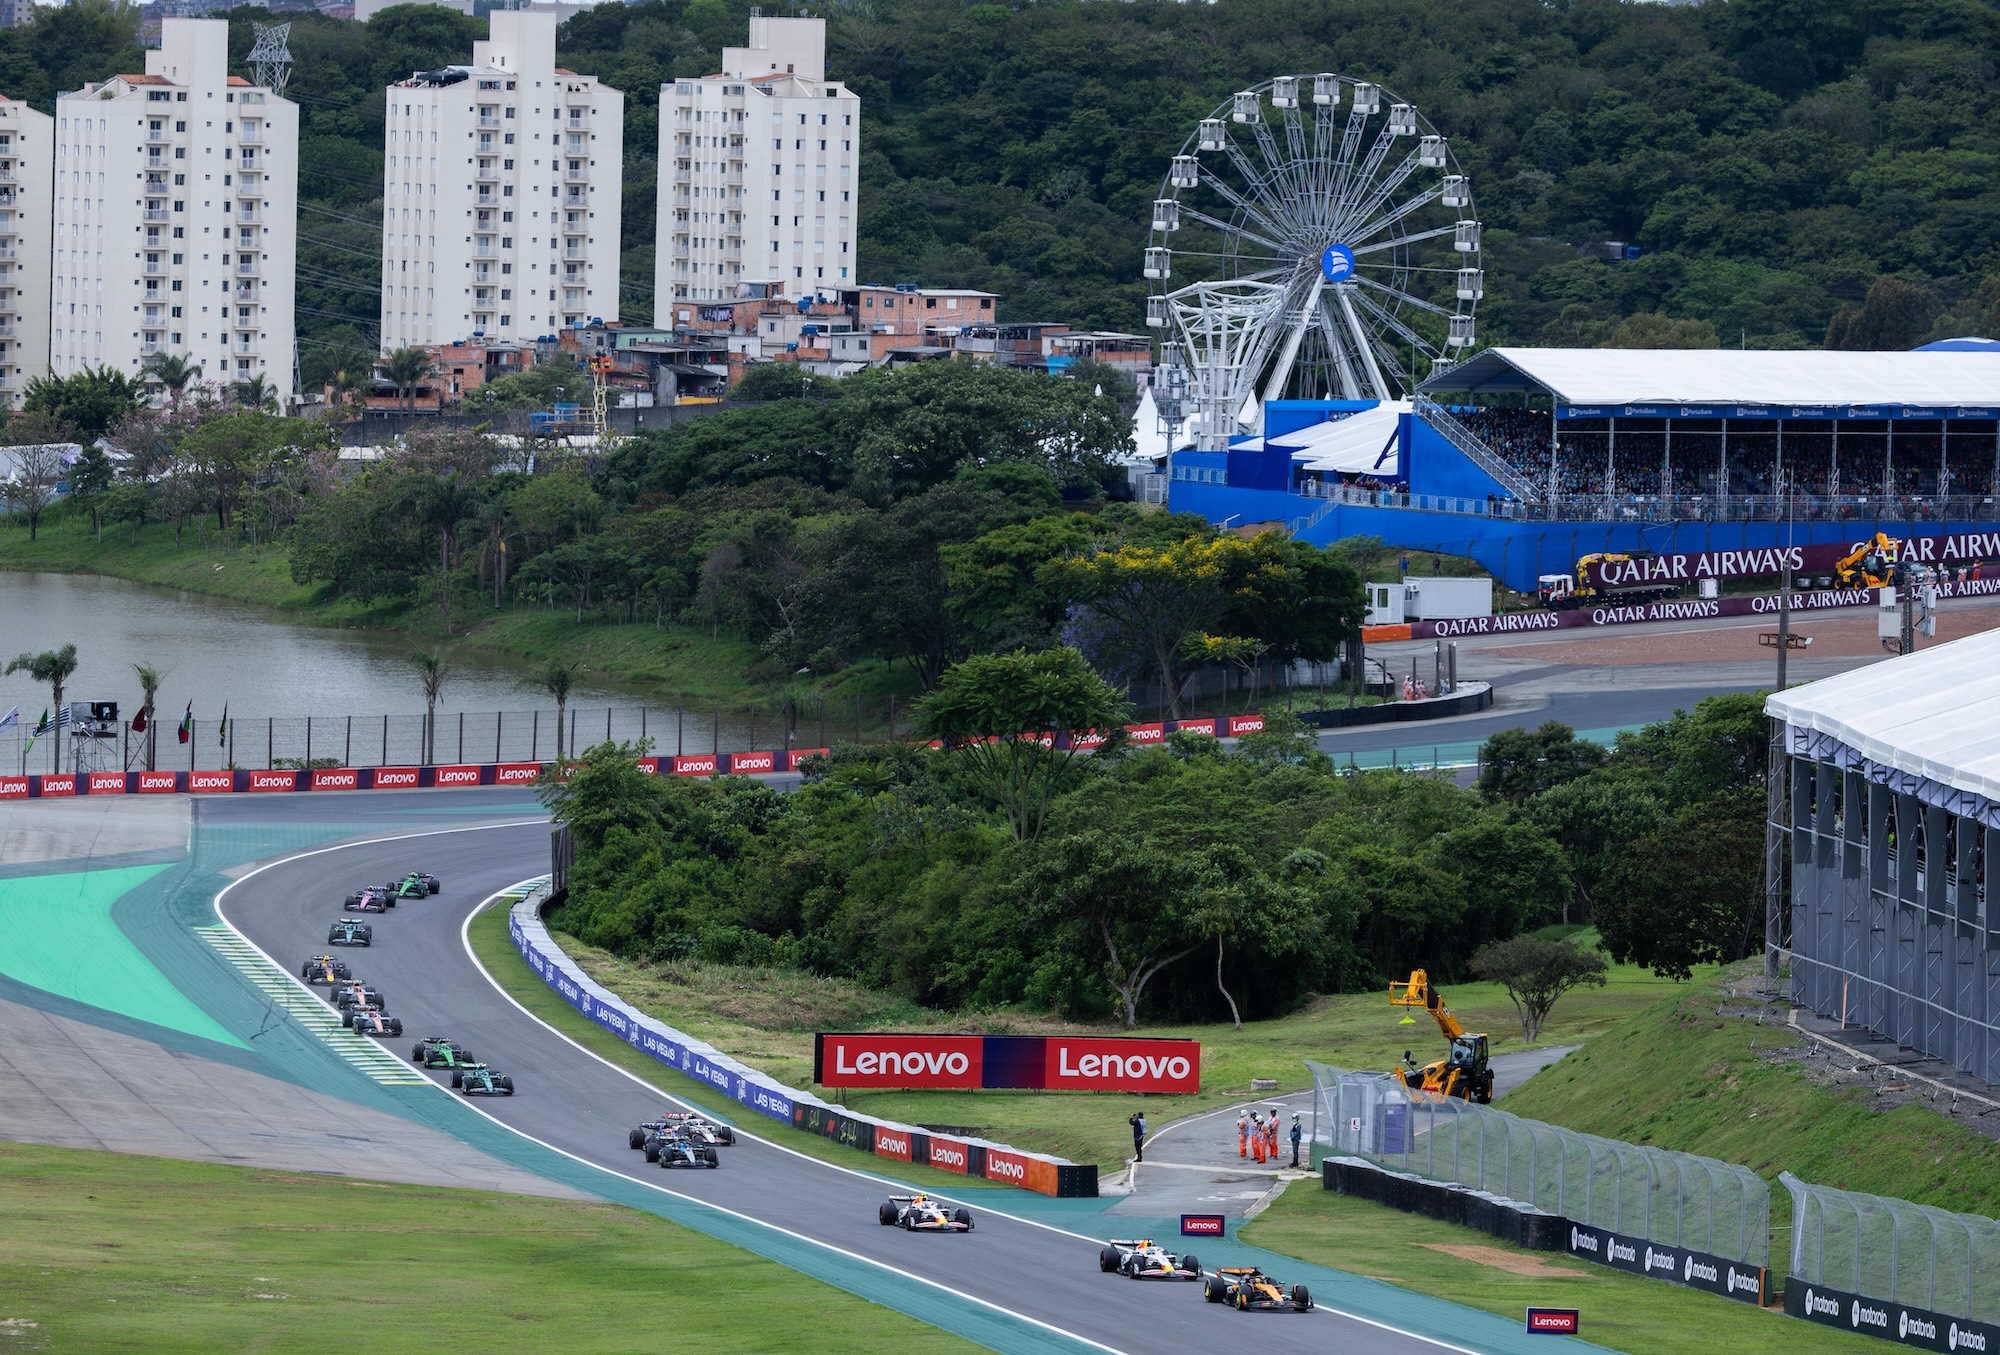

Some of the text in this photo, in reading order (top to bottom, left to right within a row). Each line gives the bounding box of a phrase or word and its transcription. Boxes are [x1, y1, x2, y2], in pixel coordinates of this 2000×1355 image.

[1575, 408, 1601, 416] PortoBank
[1632, 407, 1657, 415] PortoBank
[1687, 408, 1712, 416] PortoBank
[1743, 408, 1768, 416] PortoBank
[1799, 409, 1824, 417] PortoBank
[1855, 409, 1880, 417] PortoBank
[1910, 409, 1935, 417] PortoBank
[1964, 409, 1989, 417] PortoBank
[1600, 547, 1804, 585] QATAR AIRWAYS
[1807, 588, 1871, 609] AIRWAYS
[1592, 600, 1719, 626] QATAR AIRWAYS
[1435, 612, 1560, 637] QATAR AIRWAYS
[1233, 720, 1263, 732] Lenovo
[1128, 729, 1160, 740] enovo
[678, 760, 713, 773] Lenovo
[735, 757, 770, 769] Lenovo
[315, 774, 354, 786] Lenovo
[377, 772, 416, 785] Lenovo
[440, 770, 477, 783] Lenovo
[499, 767, 536, 780] Lenovo
[0, 781, 26, 794] Lenovo
[44, 779, 73, 792] Lenovo
[91, 777, 123, 789] Lenovo
[141, 776, 174, 788] Lenovo
[192, 776, 230, 787] Lenovo
[253, 775, 293, 787] Lenovo
[596, 1005, 627, 1032] LAS VEGAS
[643, 1034, 656, 1051] LAS
[836, 1045, 1191, 1080] Lenovo Lenovo
[695, 1061, 709, 1078] LAS
[753, 1090, 768, 1108] LAS
[876, 1131, 907, 1155] Lenovo
[930, 1143, 964, 1167] Lenovo
[989, 1154, 1024, 1180] Lenovo
[1186, 1220, 1219, 1231] Lenovo
[1577, 1232, 1597, 1251] motorola
[1613, 1243, 1635, 1262] motorola
[1652, 1252, 1674, 1270] motorola
[1692, 1262, 1717, 1282] motorola
[1735, 1273, 1759, 1293] motorola
[1813, 1295, 1839, 1316] motorola
[1535, 1316, 1570, 1327] Lenovo
[1859, 1306, 1887, 1327] motorola
[1907, 1318, 1936, 1339] motorola
[1957, 1330, 1985, 1350] motorola
